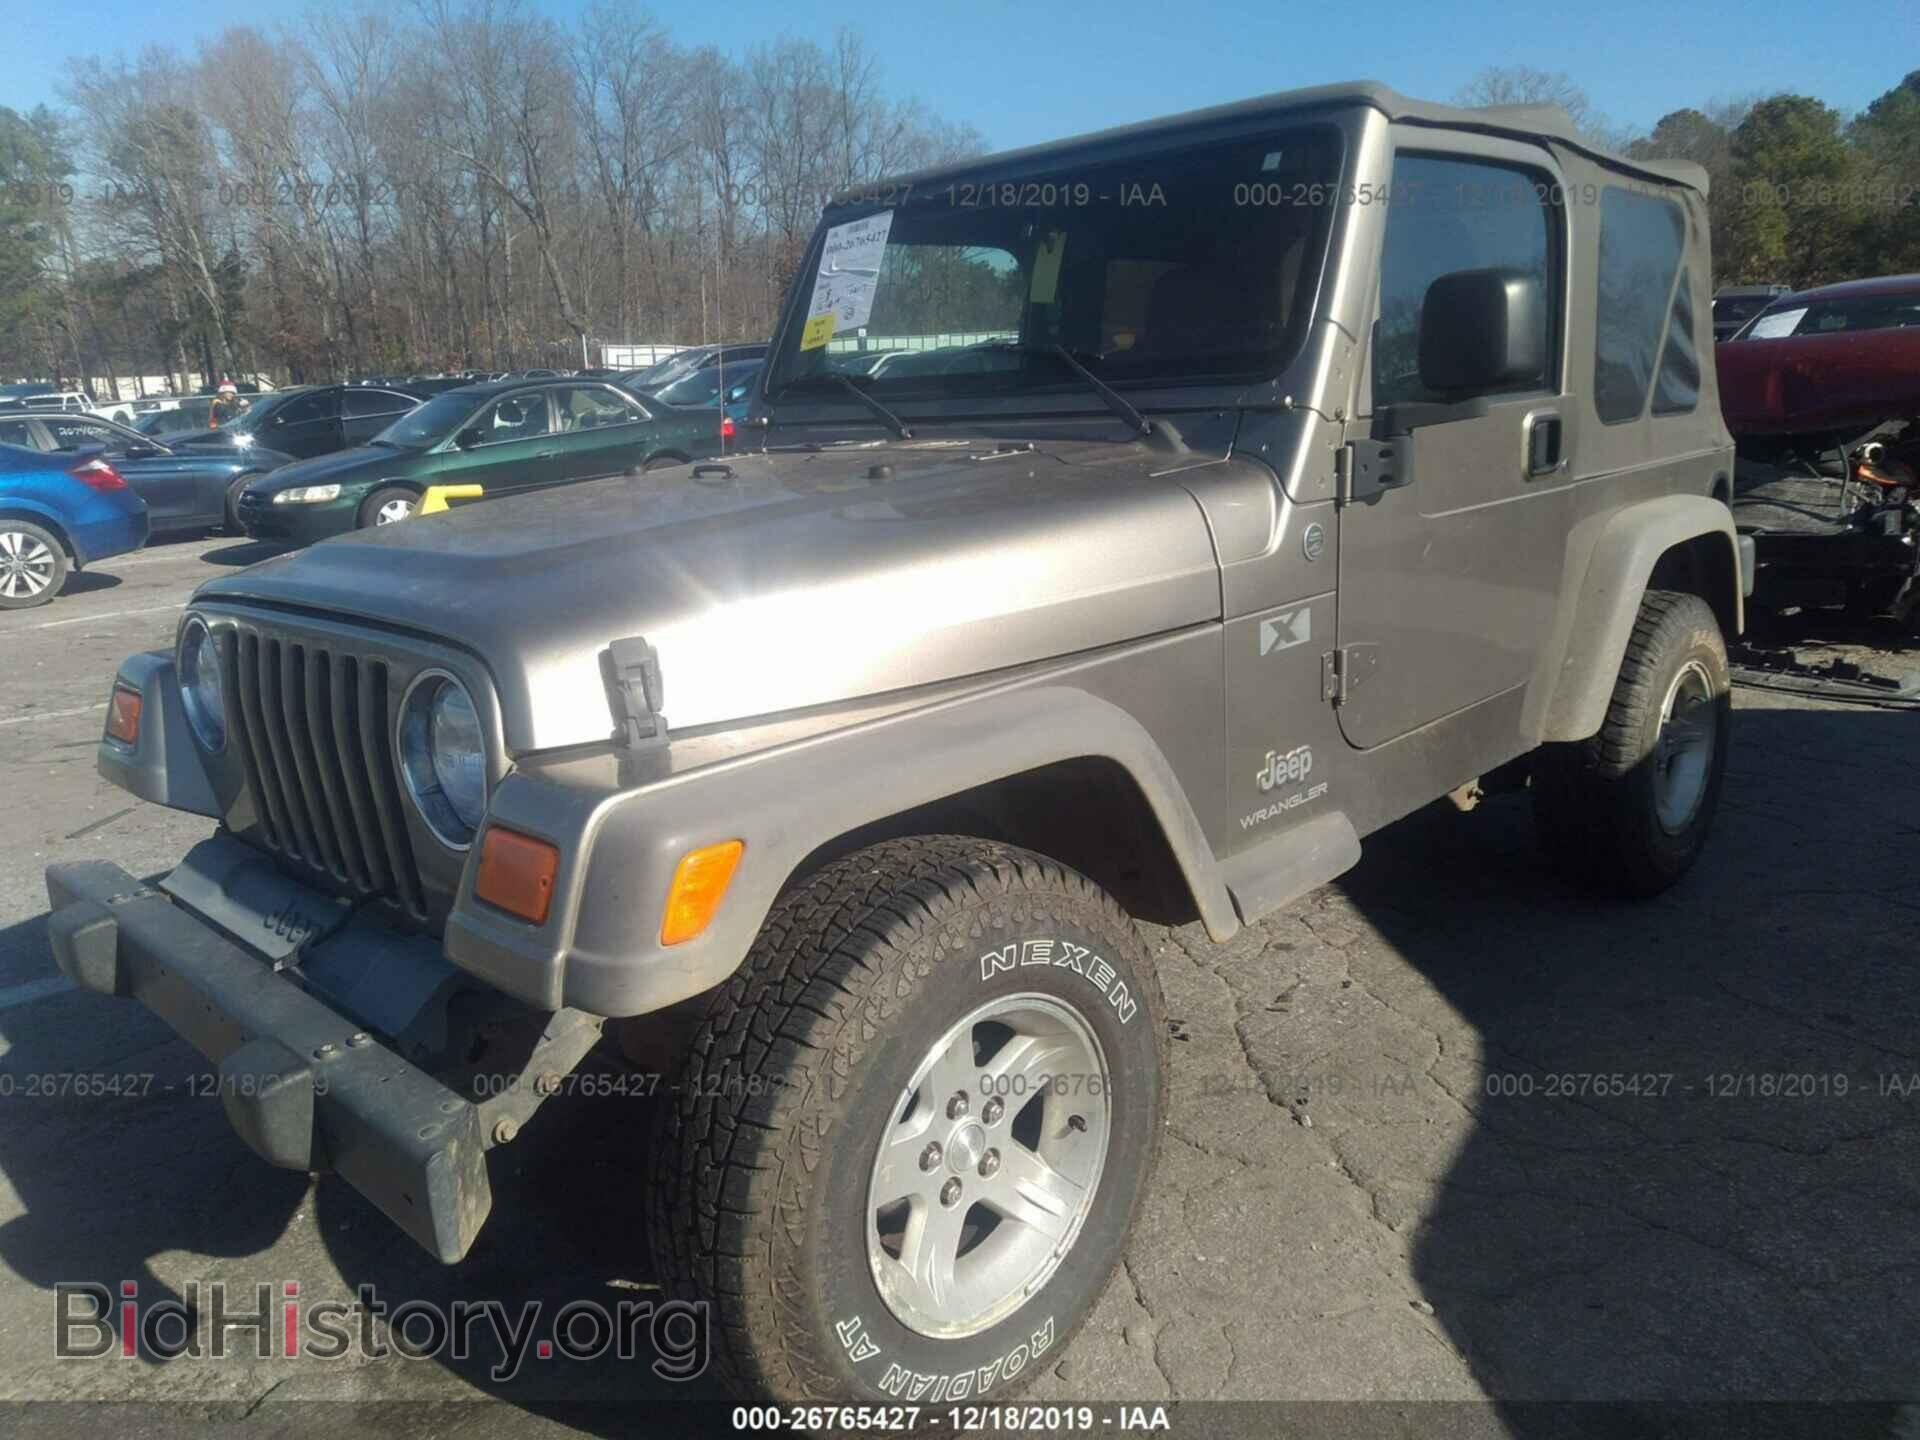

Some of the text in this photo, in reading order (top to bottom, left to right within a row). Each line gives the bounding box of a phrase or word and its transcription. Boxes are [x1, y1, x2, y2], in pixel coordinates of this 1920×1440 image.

[1257, 745, 1312, 791] Jeep
[1240, 782, 1328, 829] WRANGLER
[981, 940, 1137, 1024] NEXEN
[835, 1316, 1055, 1403] ROADIAN AT
